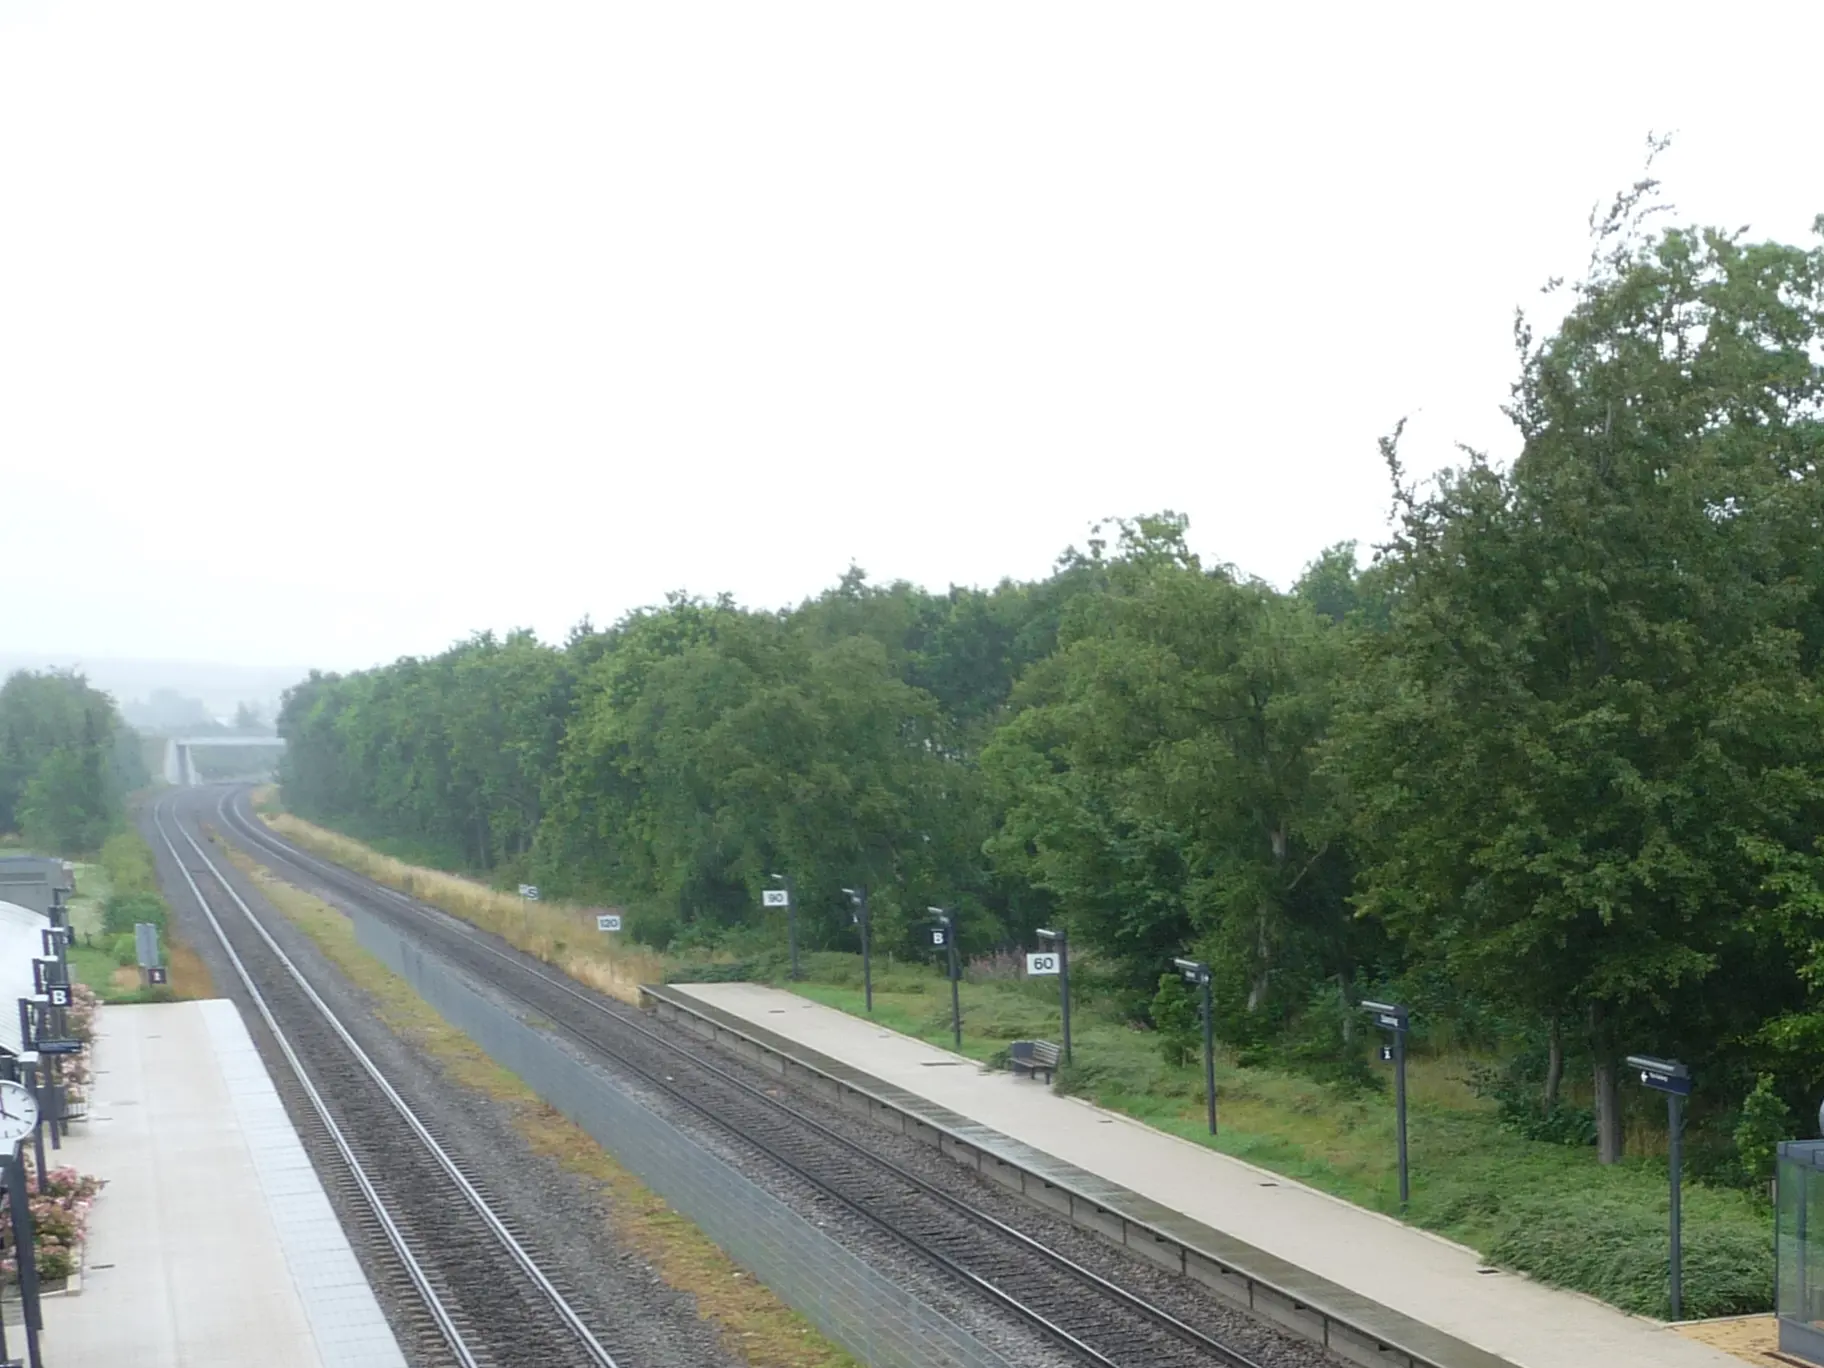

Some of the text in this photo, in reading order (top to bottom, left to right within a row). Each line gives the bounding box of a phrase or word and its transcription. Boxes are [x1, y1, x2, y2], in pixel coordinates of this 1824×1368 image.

[933, 931, 944, 944] B
[1034, 957, 1053, 970] 60
[52, 990, 67, 1004] B
